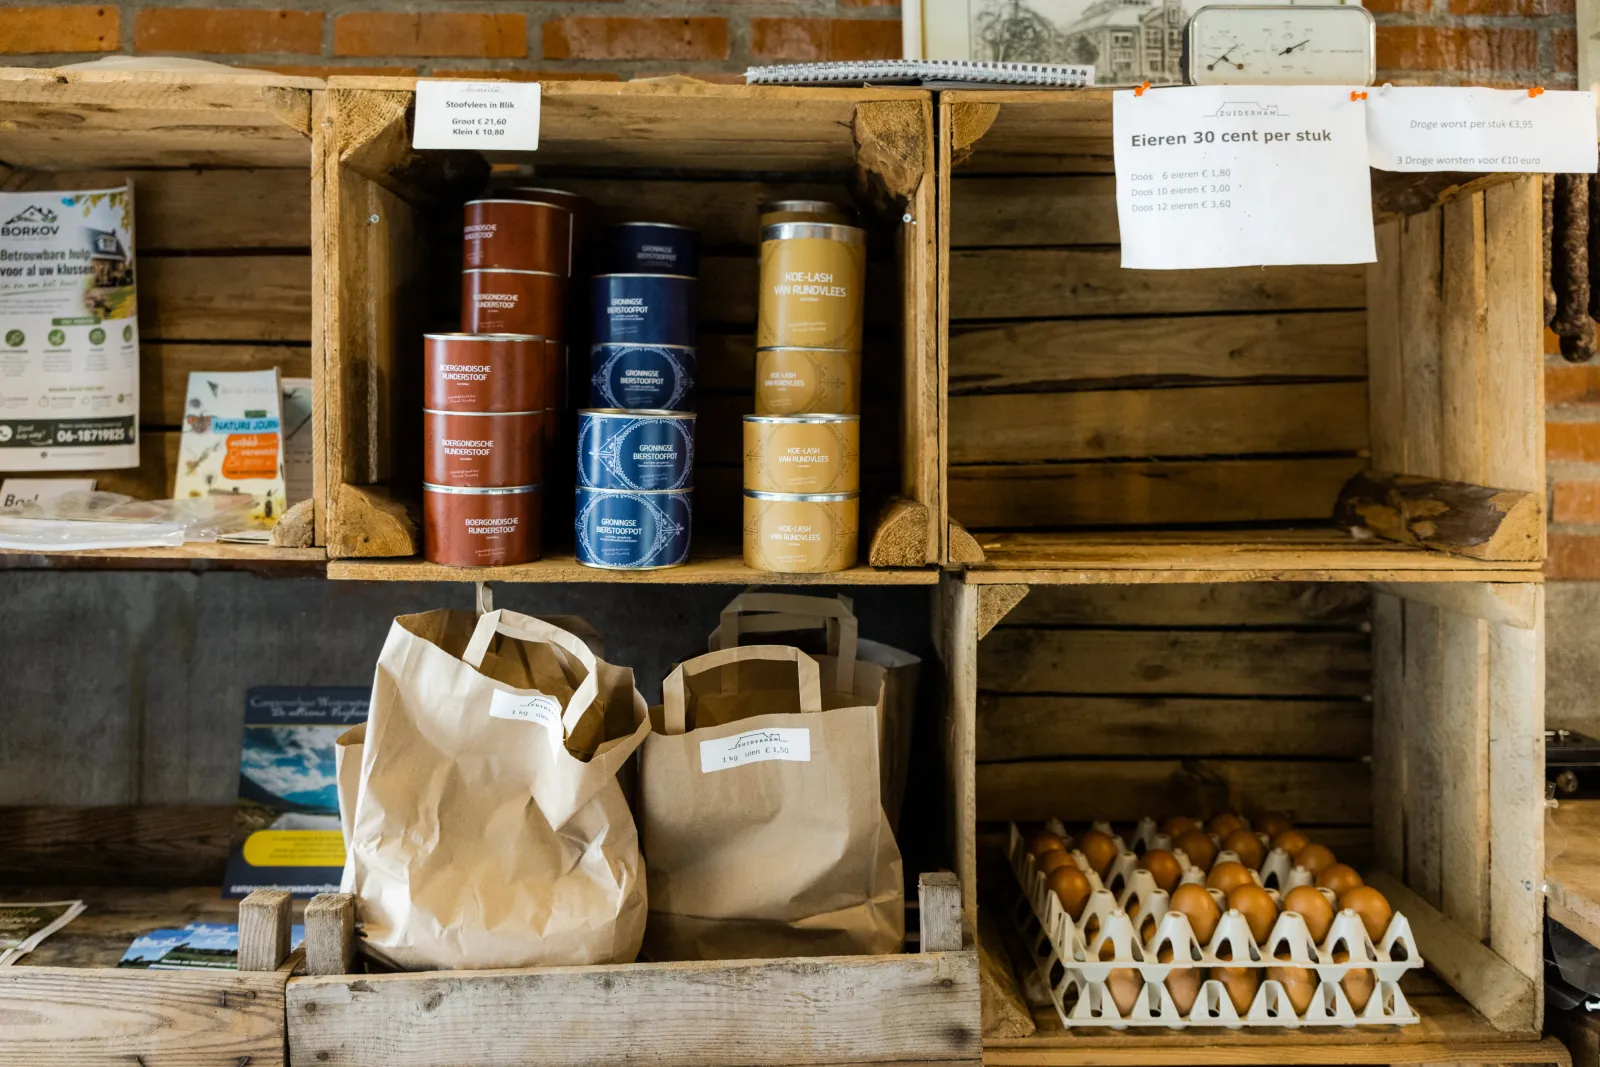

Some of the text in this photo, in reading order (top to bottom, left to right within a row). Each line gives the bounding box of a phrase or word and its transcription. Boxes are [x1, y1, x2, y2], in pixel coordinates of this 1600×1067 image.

[446, 101, 515, 109] Stoofvlees in Blik
[484, 118, 507, 126] 21,60
[1410, 119, 1533, 130] Droge worst per stuk €3,95
[452, 128, 473, 136] Klein
[483, 128, 505, 136] 10,80
[1131, 129, 1332, 147] Eieren 30 cent per stuk
[1397, 157, 1403, 165] 3
[1405, 156, 1434, 166] Droge
[1436, 156, 1475, 165] worsten
[1478, 157, 1499, 165] voor
[1501, 156, 1519, 165] €10
[1131, 173, 1153, 182] Doos
[1162, 171, 1168, 180] 6
[1170, 170, 1199, 179] eieren
[1211, 169, 1231, 179] 1,80
[1131, 188, 1153, 197] Doos
[1157, 187, 1168, 196] 10
[1170, 186, 1199, 195] eieren
[1210, 185, 1231, 194] 3,00
[1132, 203, 1154, 212] Doos
[1157, 203, 1168, 211] 12
[1170, 201, 1199, 210] eieren
[1211, 200, 1231, 209] 3,60
[1, 226, 59, 236] BORKOV
[0, 249, 91, 261] Betrouwbare hulp
[0, 264, 96, 277] voor al uw klussen
[785, 272, 833, 283] KOE-LASH
[774, 285, 846, 297] VAN RUNDVLEES
[440, 364, 491, 372] BOERGONDISCHE
[442, 373, 487, 381] RUNDERSTOOF
[441, 439, 493, 447] BOERGONDISCHE
[444, 448, 490, 456] RUNDERSTOOF
[639, 444, 674, 452] GRONINGSE
[633, 452, 677, 460] BIERSTOOFPOT
[465, 517, 518, 526] BOERGONDISCHE
[468, 526, 516, 534] RUNDERSTOOF
[596, 526, 642, 535] BIERSTOOFPOT
[783, 533, 820, 541] RUNDVLEES
[738, 737, 779, 747] ZUIDERHAM
[745, 749, 760, 757] uien
